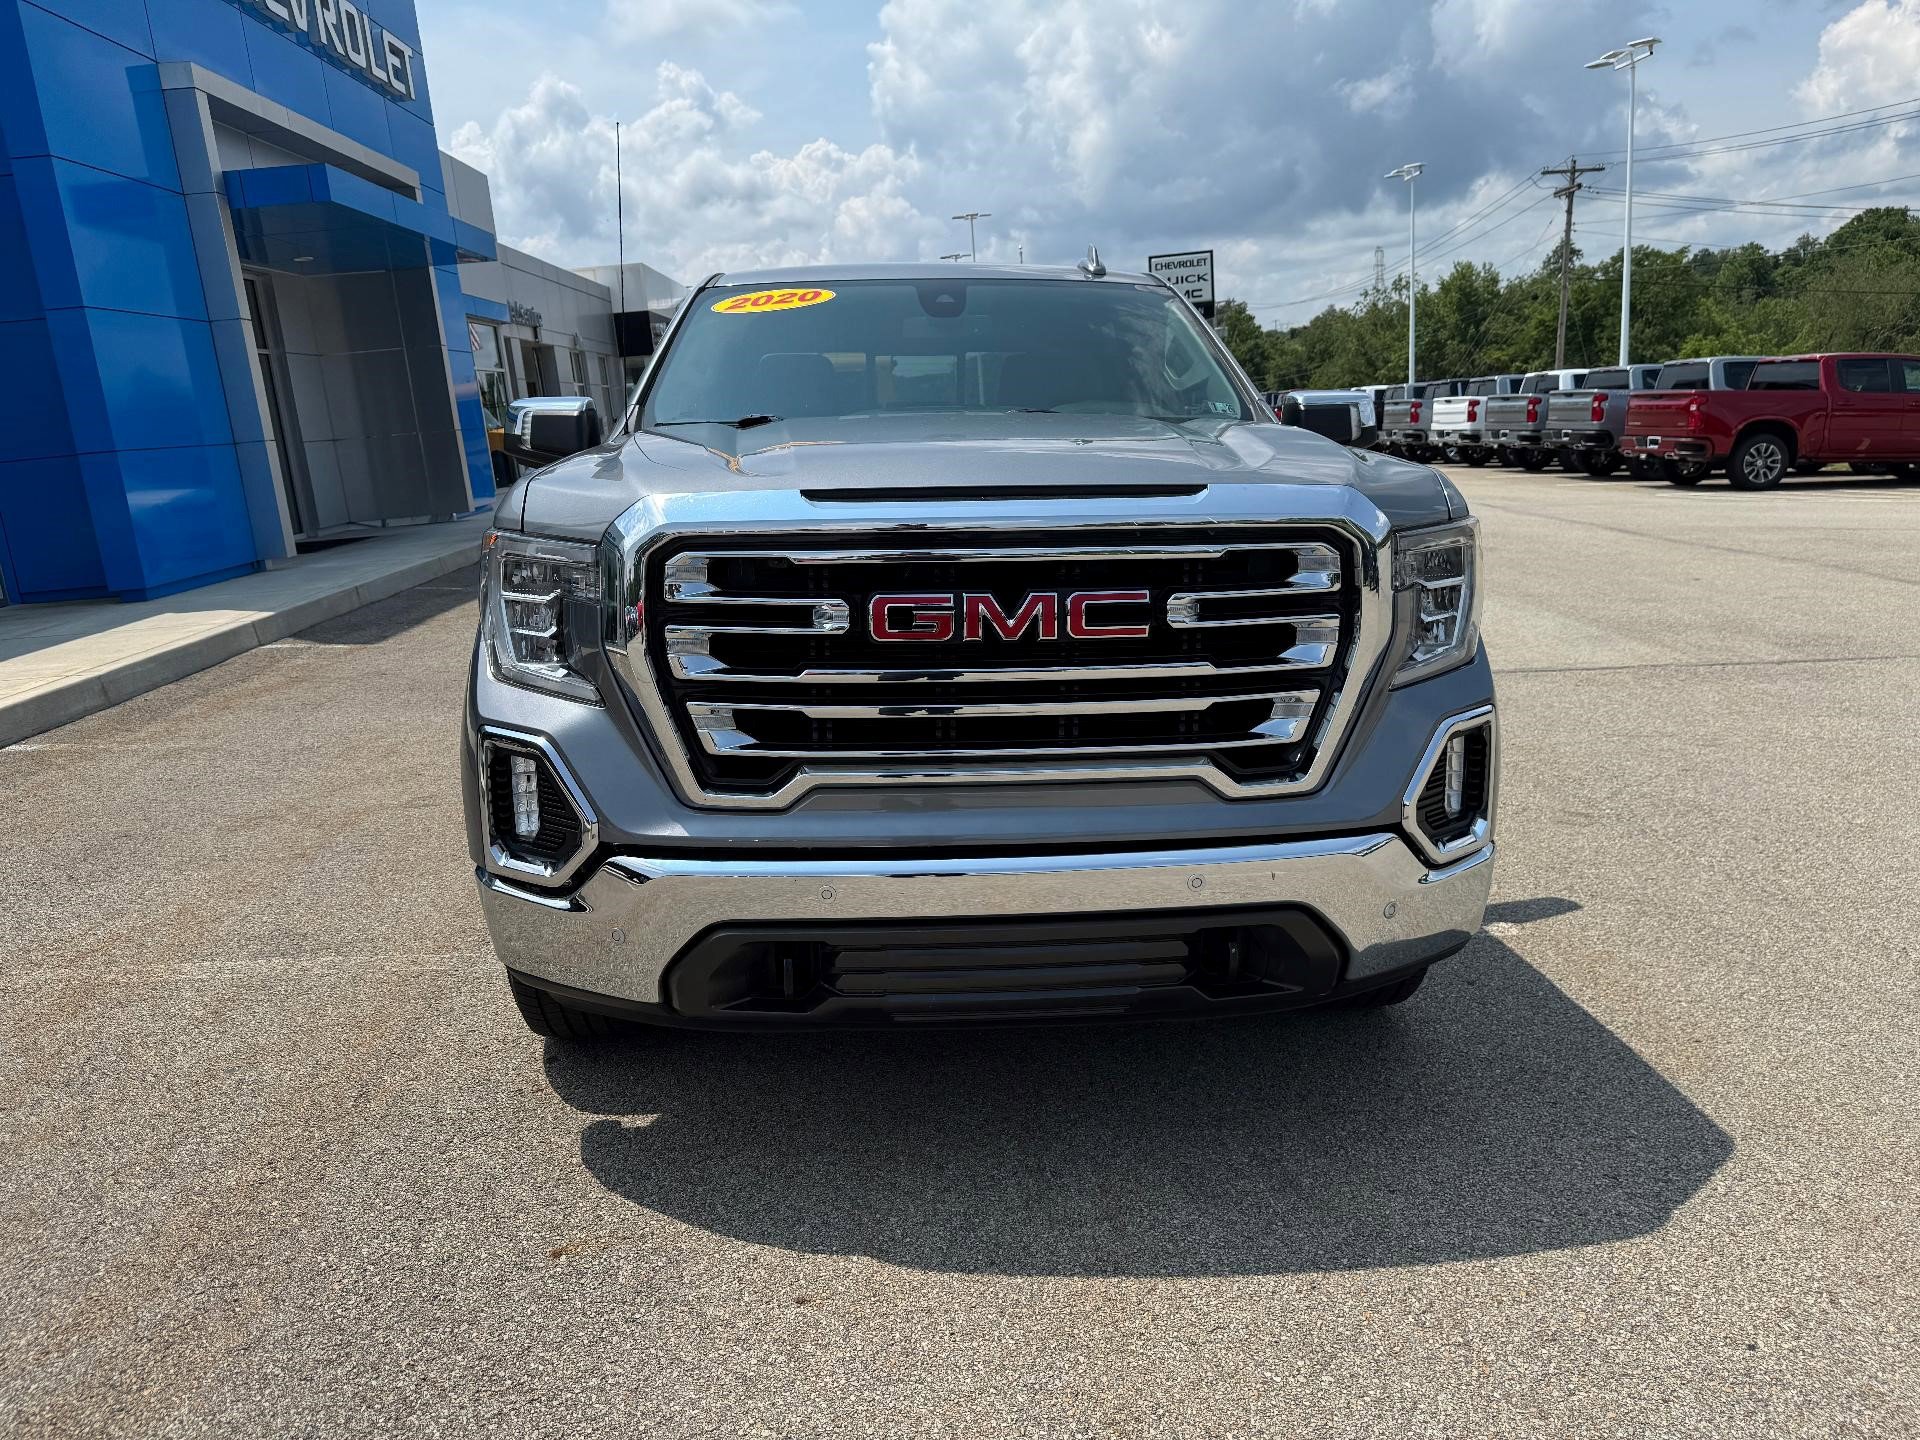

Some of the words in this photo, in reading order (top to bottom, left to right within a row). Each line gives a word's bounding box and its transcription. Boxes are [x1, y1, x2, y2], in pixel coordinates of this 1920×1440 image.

[1154, 257, 1208, 271] CHEVROLET
[1168, 273, 1209, 285] UICK
[724, 290, 822, 311] 2020
[869, 590, 1150, 642] GMC
